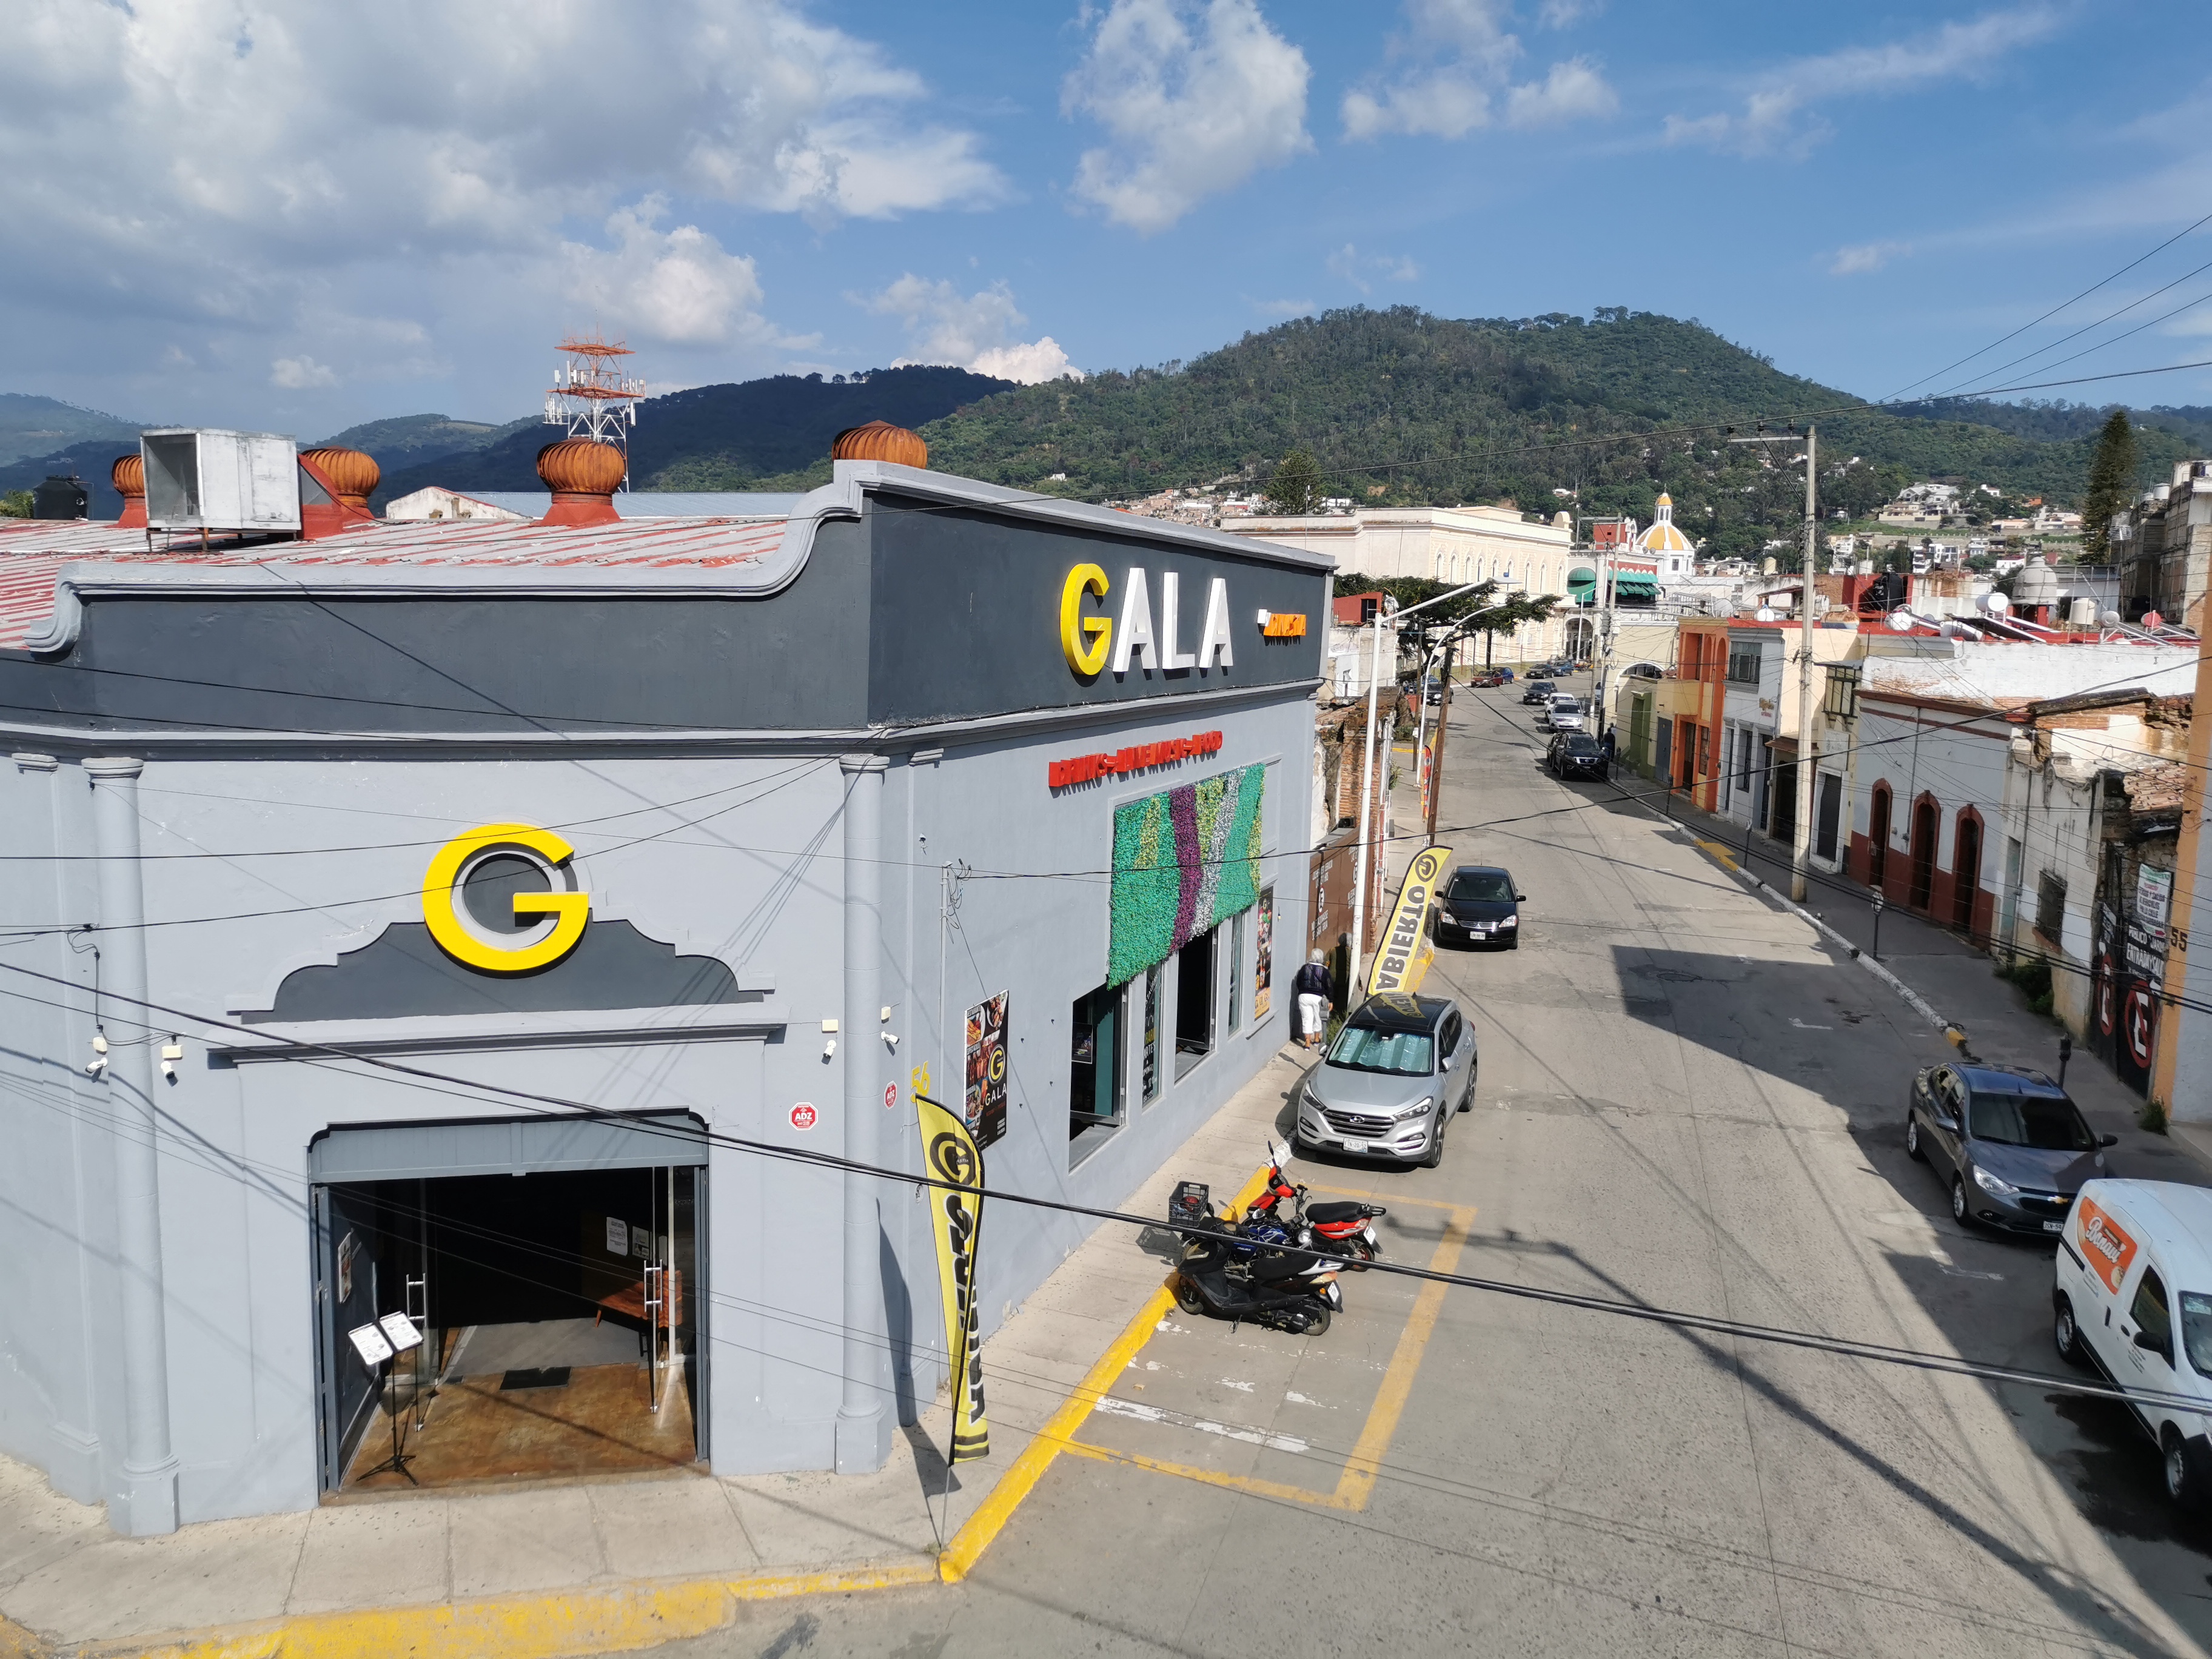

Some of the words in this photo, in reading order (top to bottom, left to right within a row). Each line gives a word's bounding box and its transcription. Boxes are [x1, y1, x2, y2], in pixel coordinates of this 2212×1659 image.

[1061, 563, 1234, 675] GALA
[1192, 730, 1223, 756] FOOD
[422, 822, 589, 971] G
[2171, 927, 2188, 952] 55
[910, 1060, 931, 1103] 56
[985, 1082, 1007, 1107] GALA
[794, 1112, 813, 1121] ADZ
